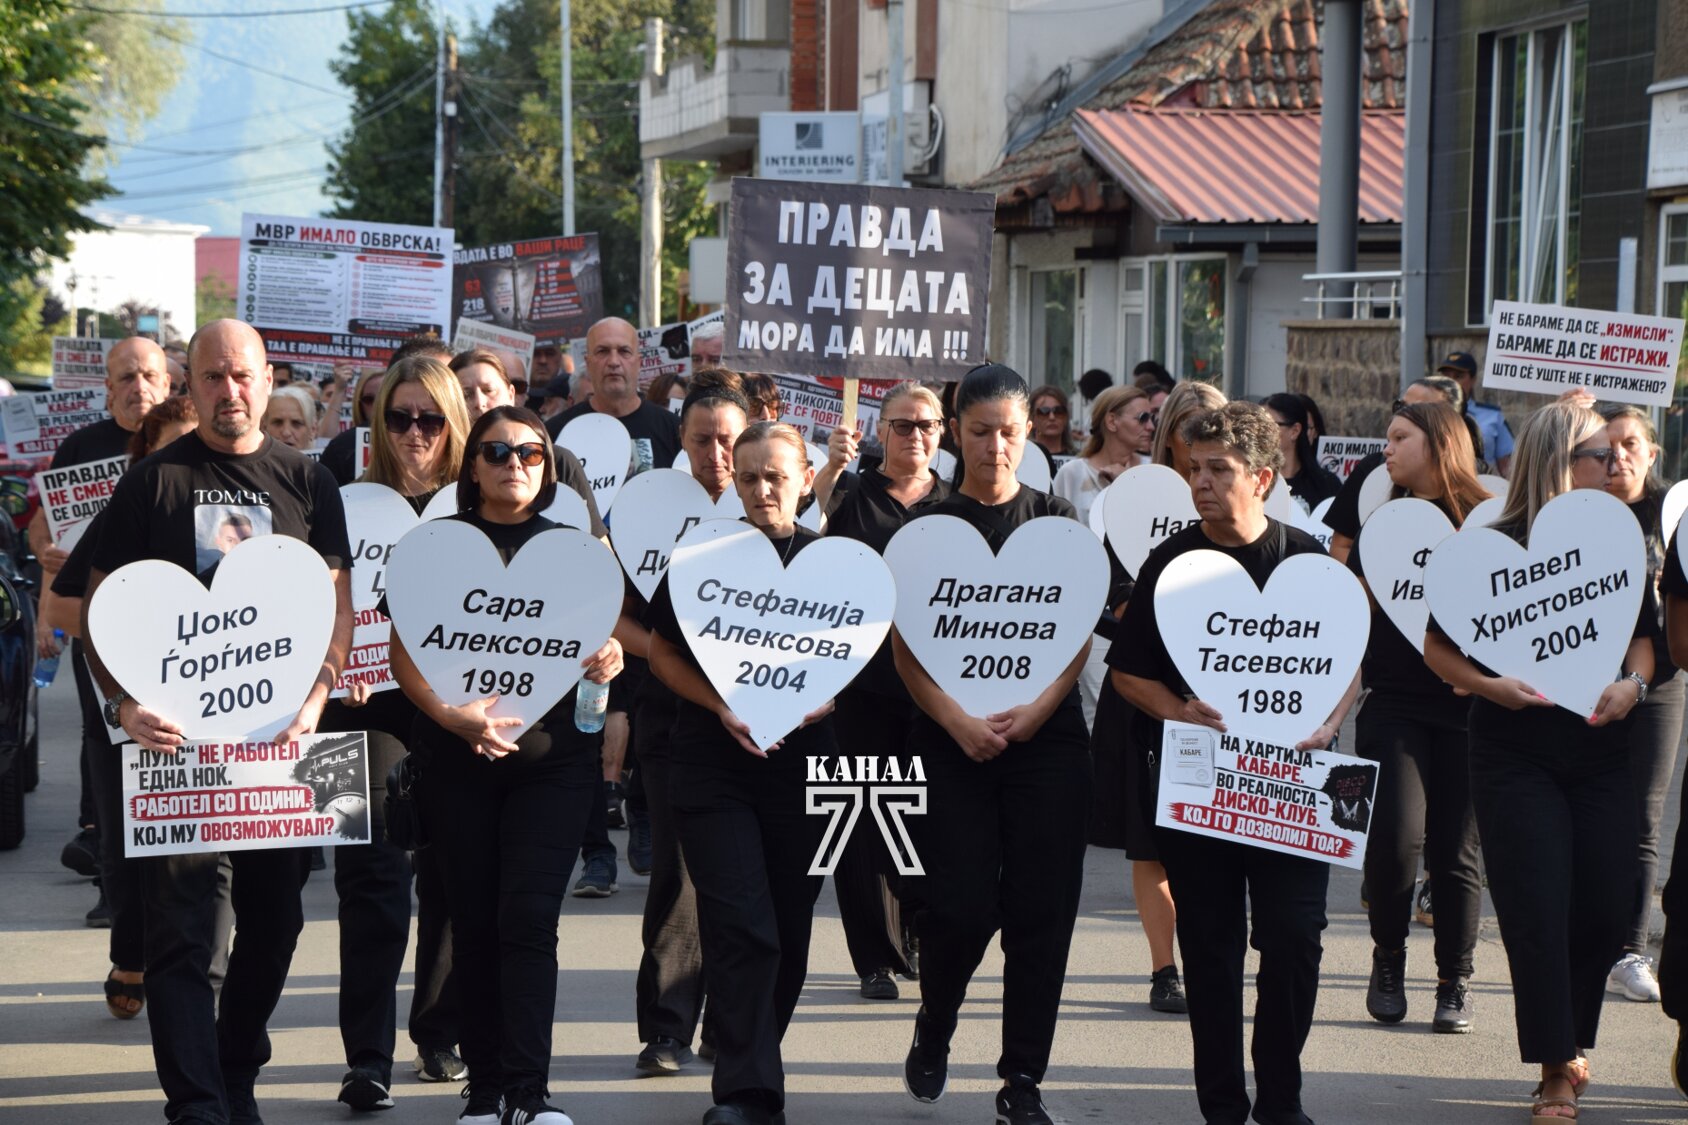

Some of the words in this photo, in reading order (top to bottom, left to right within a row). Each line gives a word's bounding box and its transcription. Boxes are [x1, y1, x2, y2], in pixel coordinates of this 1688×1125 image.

[765, 155, 855, 167] INTERIERING
[255, 223, 295, 240] МВР
[300, 227, 356, 244] ИМАЛО
[361, 232, 441, 251] ОБВРСКА!
[778, 200, 943, 258] ПРАВДА
[454, 248, 488, 264] ВДАТА
[498, 245, 513, 258] ВО
[463, 298, 484, 312] 218
[743, 261, 792, 305] ЗА
[807, 265, 970, 319] ДЕЦАТА
[1500, 312, 1514, 325] НЕ
[1517, 313, 1564, 331] БАРАМЕ
[1565, 319, 1582, 334] ДА
[1585, 320, 1599, 334] СЕ
[267, 341, 287, 351] ТАА
[290, 342, 296, 352] Е
[298, 343, 350, 356] ПРАШАЊЕ
[352, 348, 366, 357] НА
[738, 320, 814, 352] МОРА
[824, 325, 865, 359] ДА
[875, 327, 933, 358] ИМА
[943, 330, 968, 360] !!!
[1496, 333, 1553, 355] БАРАМЕ
[1555, 340, 1576, 359] ДА
[1580, 342, 1598, 360] СЕ
[1600, 345, 1670, 368] ИСТРАЖИ.
[861, 384, 872, 396] ЗА
[1492, 363, 1517, 378] ШТО
[1536, 368, 1566, 383] УШТЕ
[1568, 371, 1582, 385] НЕ
[1585, 373, 1590, 386] Е
[1593, 374, 1667, 394] ИСТРАЖЕНО?
[780, 389, 791, 401] ЗА
[794, 392, 844, 414] НИКОГАШ
[794, 405, 806, 417] СЕ
[1323, 442, 1343, 455] АКО
[1345, 443, 1381, 455] ИМАЛО
[43, 460, 128, 490] ПРАВДАТ
[47, 489, 70, 506] НЕ
[73, 480, 115, 502] СМЕЕ
[194, 489, 271, 506] ТОМЧЕ
[52, 506, 69, 522] СЕ
[72, 497, 111, 518] ОДЛО
[1490, 548, 1582, 598] Павел
[462, 588, 545, 622] Сара
[697, 578, 865, 628] Стефанија
[928, 578, 1062, 608] Драгана
[1471, 569, 1629, 643] Христовски
[177, 605, 258, 646] Џоко
[697, 616, 852, 661] Алексова
[933, 614, 1057, 640] Минова
[1206, 610, 1321, 643] Стефан
[1531, 618, 1599, 663] 2004
[420, 624, 582, 659] Алексова
[161, 636, 292, 685] Ѓорѓиев
[960, 655, 1031, 680] 2008
[1198, 647, 1333, 676] Тасевски
[462, 668, 535, 697] 1998
[735, 660, 808, 693] 2004
[199, 678, 273, 718] 2000
[1237, 688, 1303, 715] 1988
[198, 744, 221, 765] НЕ
[223, 741, 300, 764] РАБОТЕЛ
[321, 748, 359, 767] PULS
[1180, 748, 1202, 757] КАБАРЕ
[1220, 734, 1241, 753] НА
[1245, 739, 1313, 768] ХАРТИЈА
[139, 768, 188, 793] ЕДНА
[192, 762, 232, 787] НОЌ.
[1236, 754, 1305, 784] КАБАРЕ.
[135, 794, 209, 818] РАБОТЕЛ
[213, 793, 234, 813] СО
[240, 788, 310, 812] ГОДИНИ.
[1216, 772, 1236, 789] ВО
[1238, 778, 1316, 807] РЕАЛНОСТА
[1212, 788, 1321, 828] ДИСКО-КЛУБ.
[133, 826, 167, 847] КОЈ
[170, 824, 197, 844] МУ
[200, 816, 335, 842] ОВОЗМОЖУВАЛ?
[1182, 806, 1212, 826] КОЈ
[1214, 812, 1231, 830] ГО
[1234, 815, 1308, 845] ДОЗВОЛИЛ
[1311, 835, 1343, 854] ТОА?
